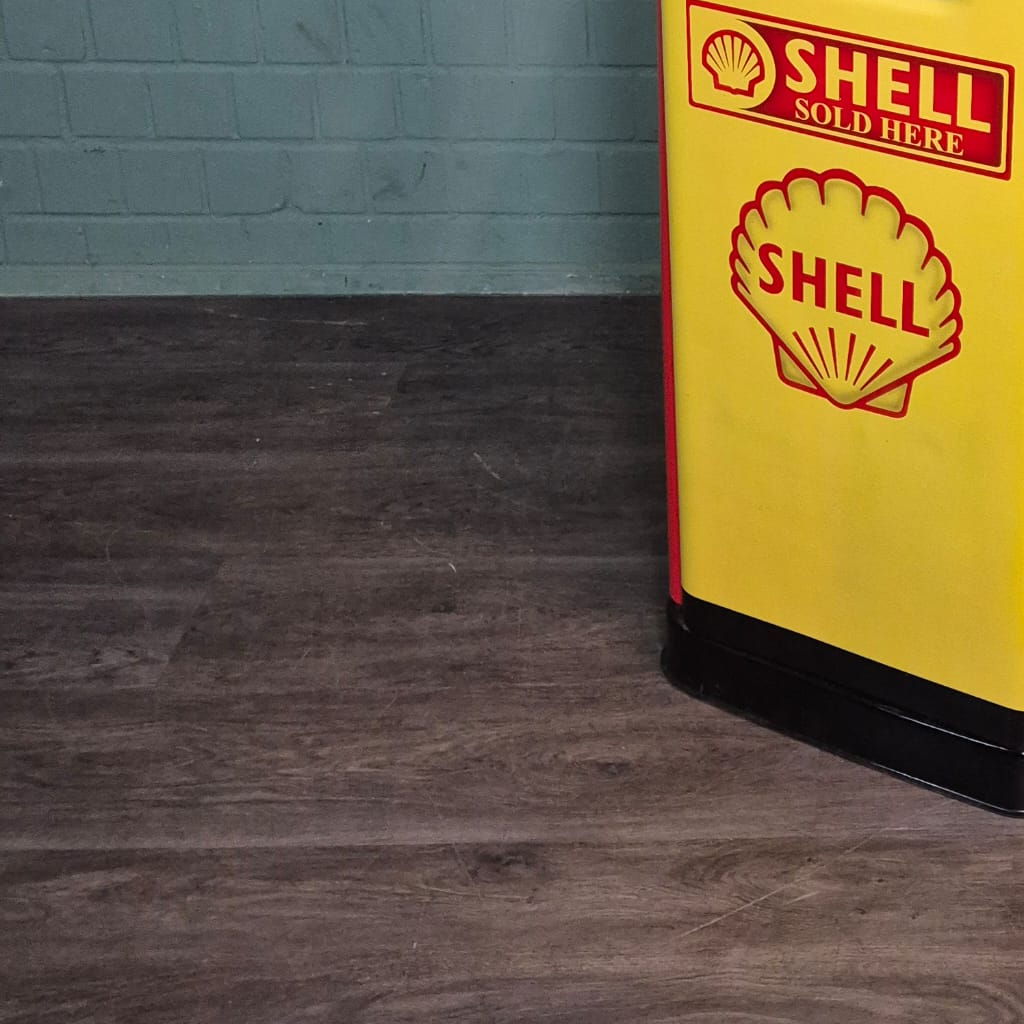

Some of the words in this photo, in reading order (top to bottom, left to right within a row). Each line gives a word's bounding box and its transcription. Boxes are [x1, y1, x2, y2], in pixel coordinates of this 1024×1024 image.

[784, 38, 991, 133] SHELL
[795, 98, 872, 134] SOLD
[880, 117, 964, 156] HERE
[758, 242, 930, 338] SHELL
